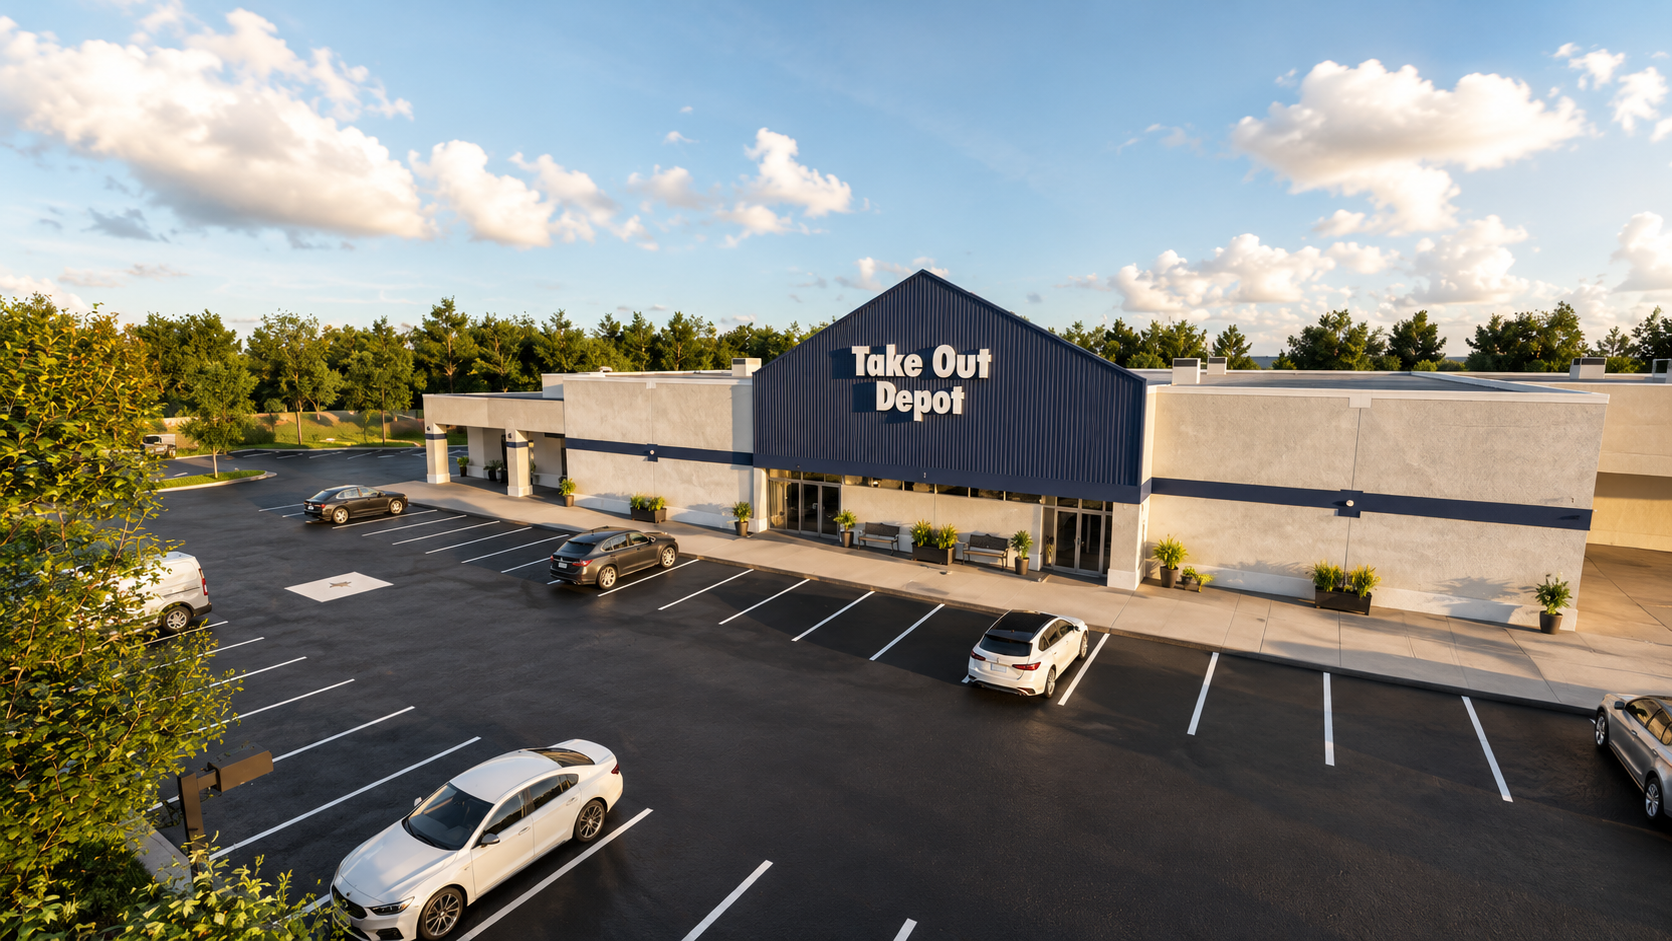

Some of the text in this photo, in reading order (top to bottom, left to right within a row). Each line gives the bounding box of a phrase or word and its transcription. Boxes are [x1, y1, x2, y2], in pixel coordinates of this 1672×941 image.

[851, 343, 992, 379] Take Out
[875, 380, 965, 422] Depot
